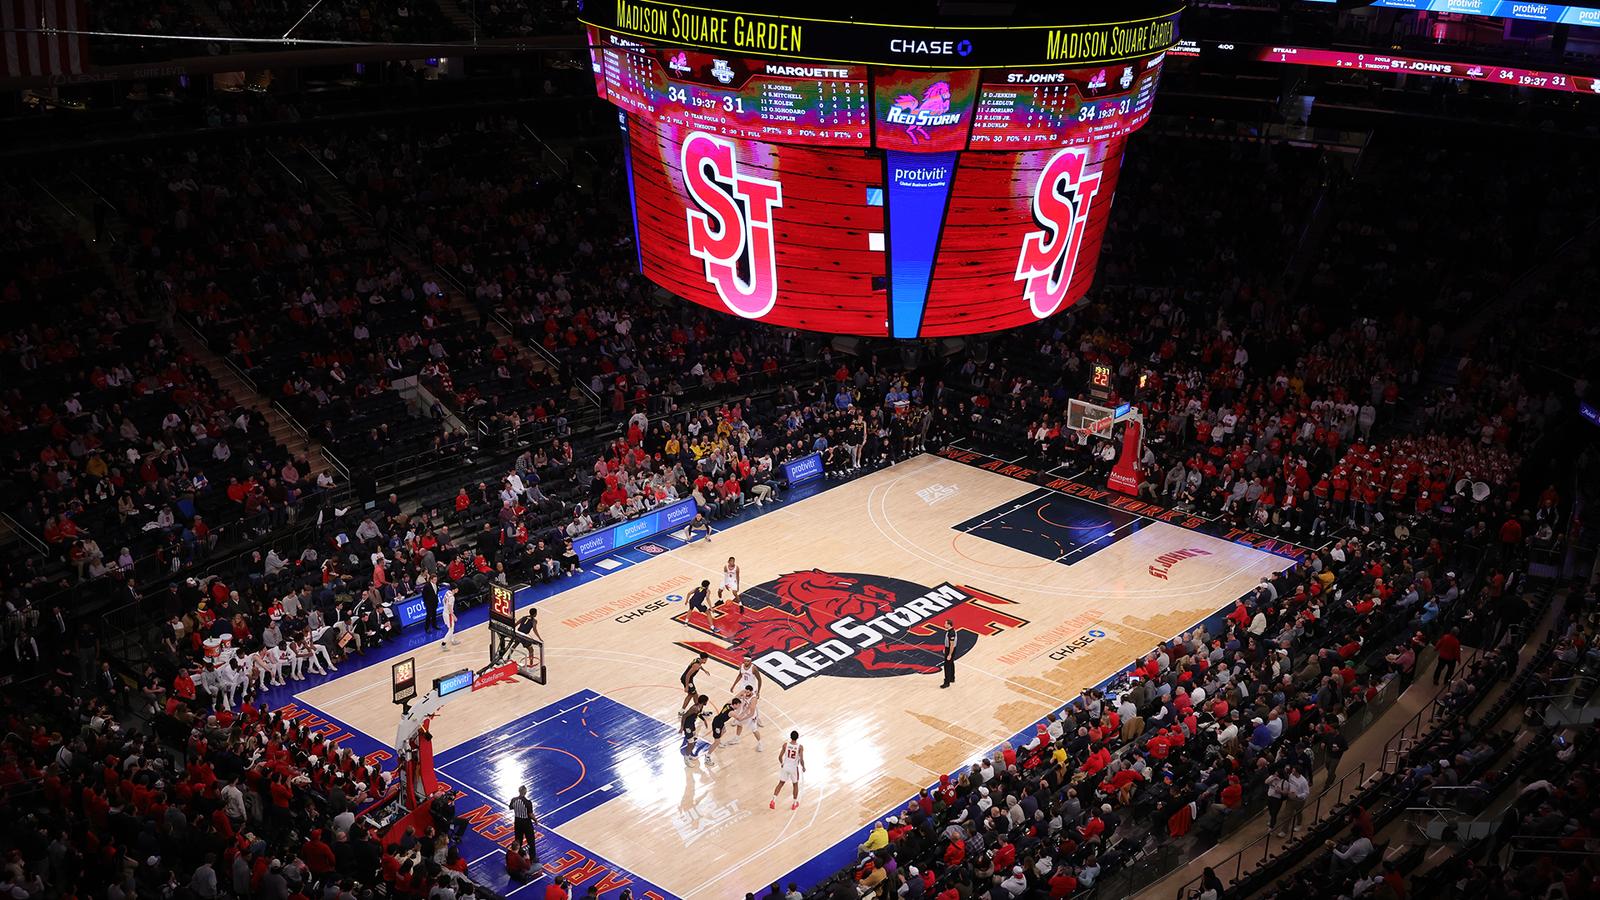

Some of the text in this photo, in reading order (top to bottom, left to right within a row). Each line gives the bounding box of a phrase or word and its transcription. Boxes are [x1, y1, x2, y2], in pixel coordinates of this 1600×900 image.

[1513, 4, 1548, 14] protiviti
[616, 0, 802, 52] MADISON SQUARE GARDEN
[890, 39, 953, 54] CHASE
[1046, 26, 1106, 60] MADISON
[1110, 22, 1147, 54] SQUARE
[766, 65, 848, 78] MARQUETTE
[1391, 60, 1451, 73] ST. JOHN'S
[1007, 73, 1065, 82] ST. JOHN'S
[1499, 70, 1513, 79] 34
[1518, 76, 1547, 86] 19:37
[1552, 76, 1566, 86] 31
[668, 87, 686, 104] 34
[692, 97, 716, 109] 19:37
[723, 96, 744, 114] 31
[1119, 99, 1131, 115] 31
[887, 106, 960, 126] RED STORM
[1078, 106, 1095, 122] 34
[1098, 108, 1115, 119] 19:37
[895, 167, 947, 181] protiviti
[1094, 374, 1107, 385] 22
[1111, 472, 1136, 483] Maspeth
[980, 461, 1038, 479] ARE
[1045, 479, 1110, 500] NEW
[1110, 496, 1206, 529] YORK'S
[1223, 528, 1304, 557] TEAM
[495, 596, 509, 615] 22
[562, 575, 692, 629] MADISON SQUARE GARDEN
[615, 600, 669, 624] CHASE
[752, 584, 968, 687] RED STORM
[1049, 636, 1095, 660] CHASE
[399, 671, 410, 682] 22
[442, 675, 469, 690] protiviti
[787, 749, 797, 759] 12
